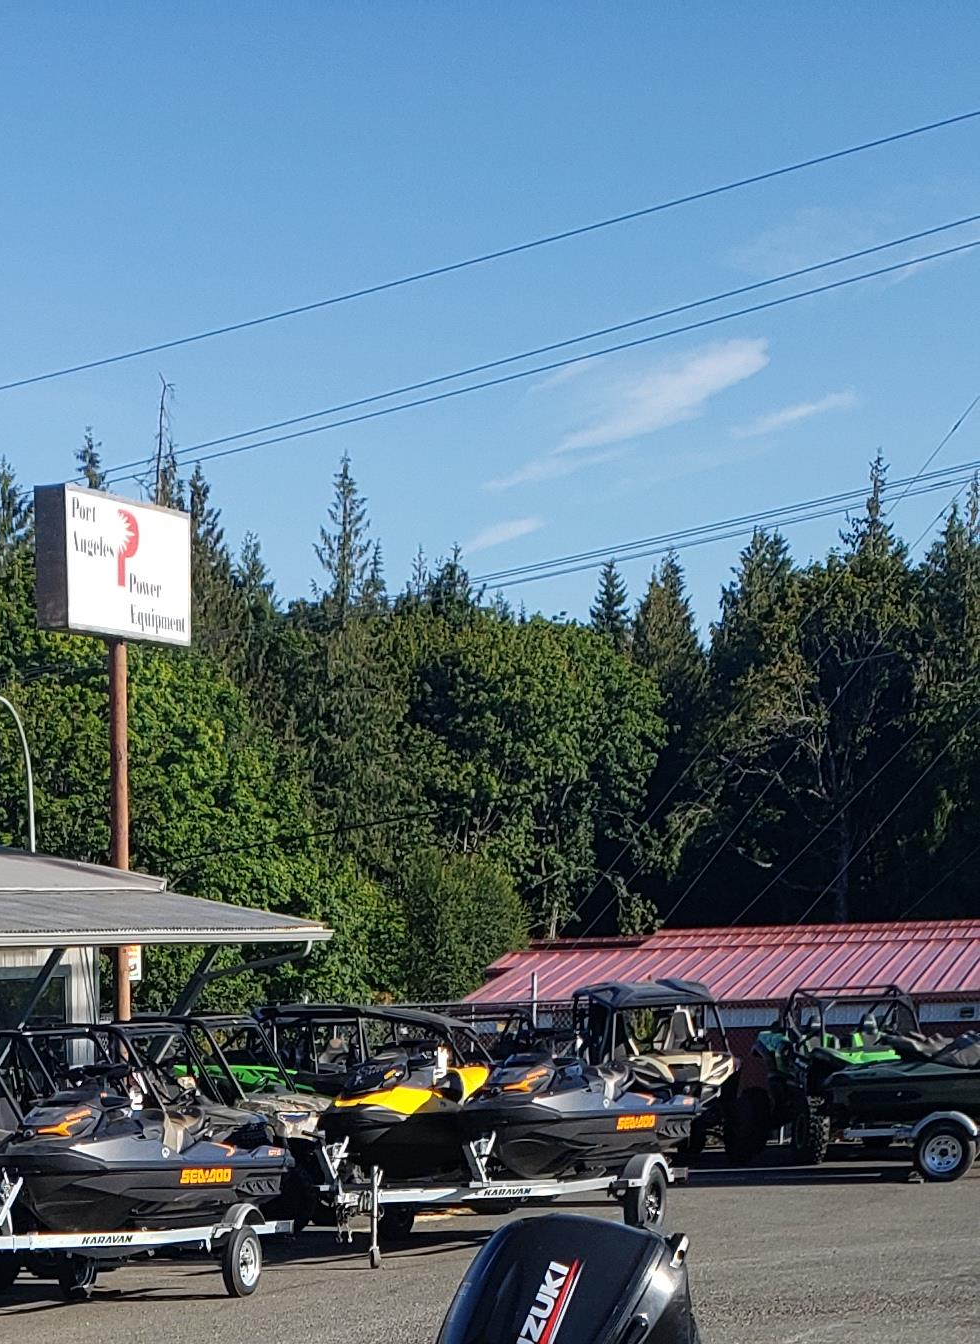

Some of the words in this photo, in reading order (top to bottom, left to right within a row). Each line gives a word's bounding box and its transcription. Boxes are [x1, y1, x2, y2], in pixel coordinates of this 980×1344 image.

[72, 497, 95, 523] Port
[72, 530, 115, 558] Angeles
[129, 572, 162, 598] Power
[130, 603, 185, 634] Equipment
[81, 1234, 134, 1245] KARAVAN
